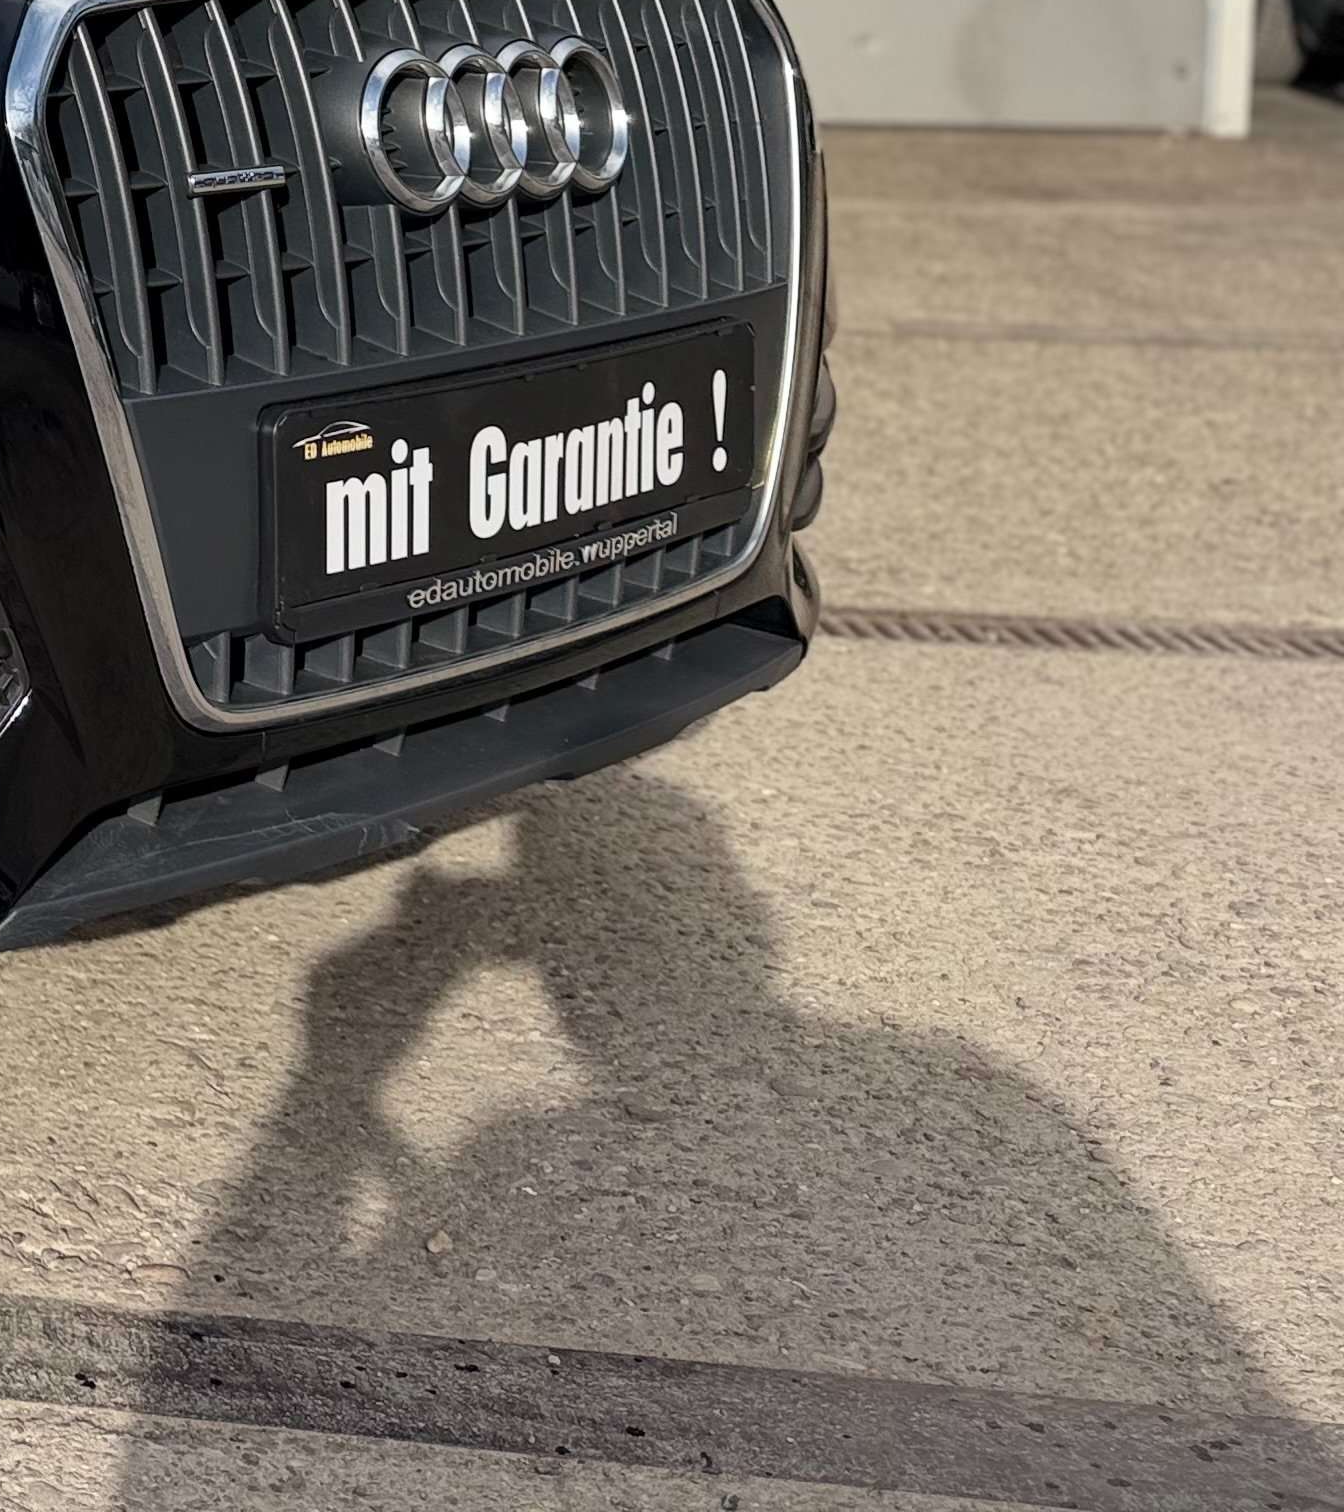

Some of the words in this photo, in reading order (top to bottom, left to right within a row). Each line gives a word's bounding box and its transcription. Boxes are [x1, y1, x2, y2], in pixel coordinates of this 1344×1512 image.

[321, 433, 374, 458] Automobile
[325, 438, 433, 575] mit
[468, 381, 685, 540] Garantie
[712, 368, 729, 472] !
[407, 511, 678, 609] edautomobile.wuppertal
